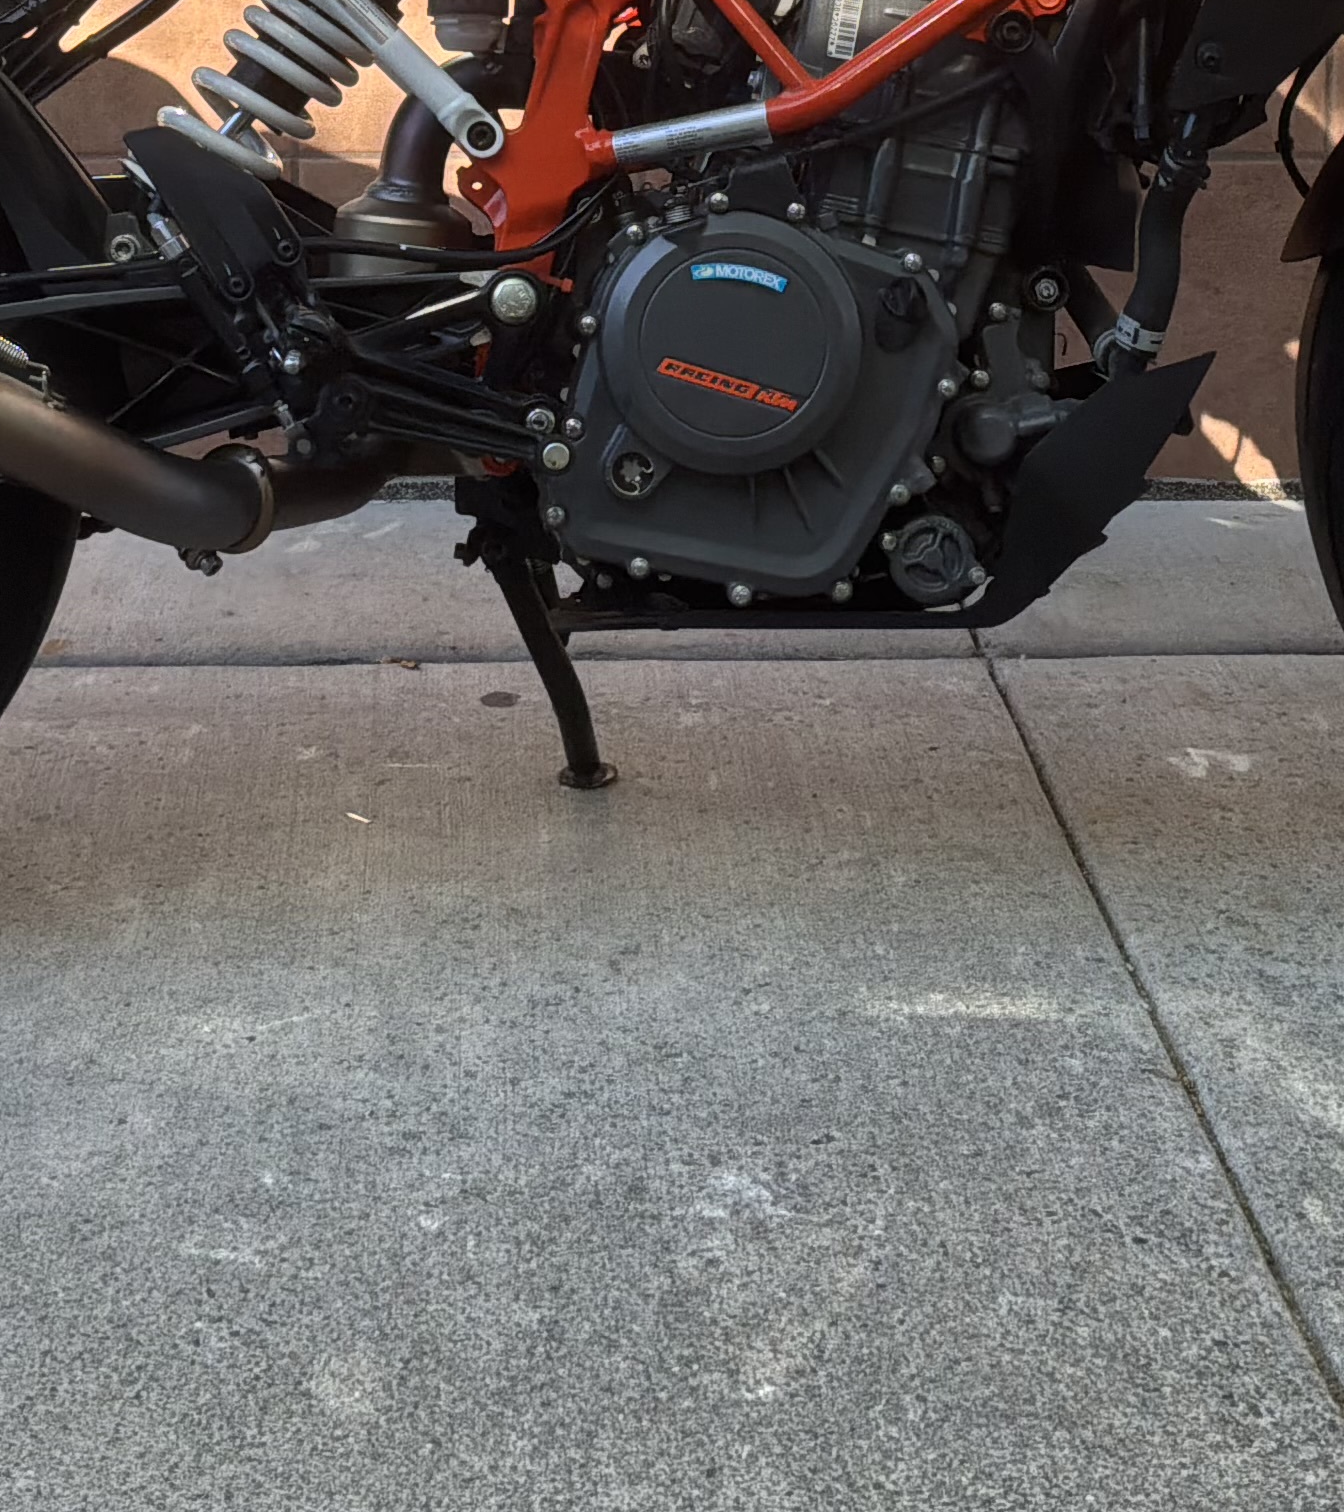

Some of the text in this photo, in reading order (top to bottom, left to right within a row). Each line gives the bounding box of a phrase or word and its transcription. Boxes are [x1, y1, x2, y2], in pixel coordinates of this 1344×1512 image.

[715, 263, 782, 291] MOTOREX
[663, 361, 798, 414] RACING KTM
